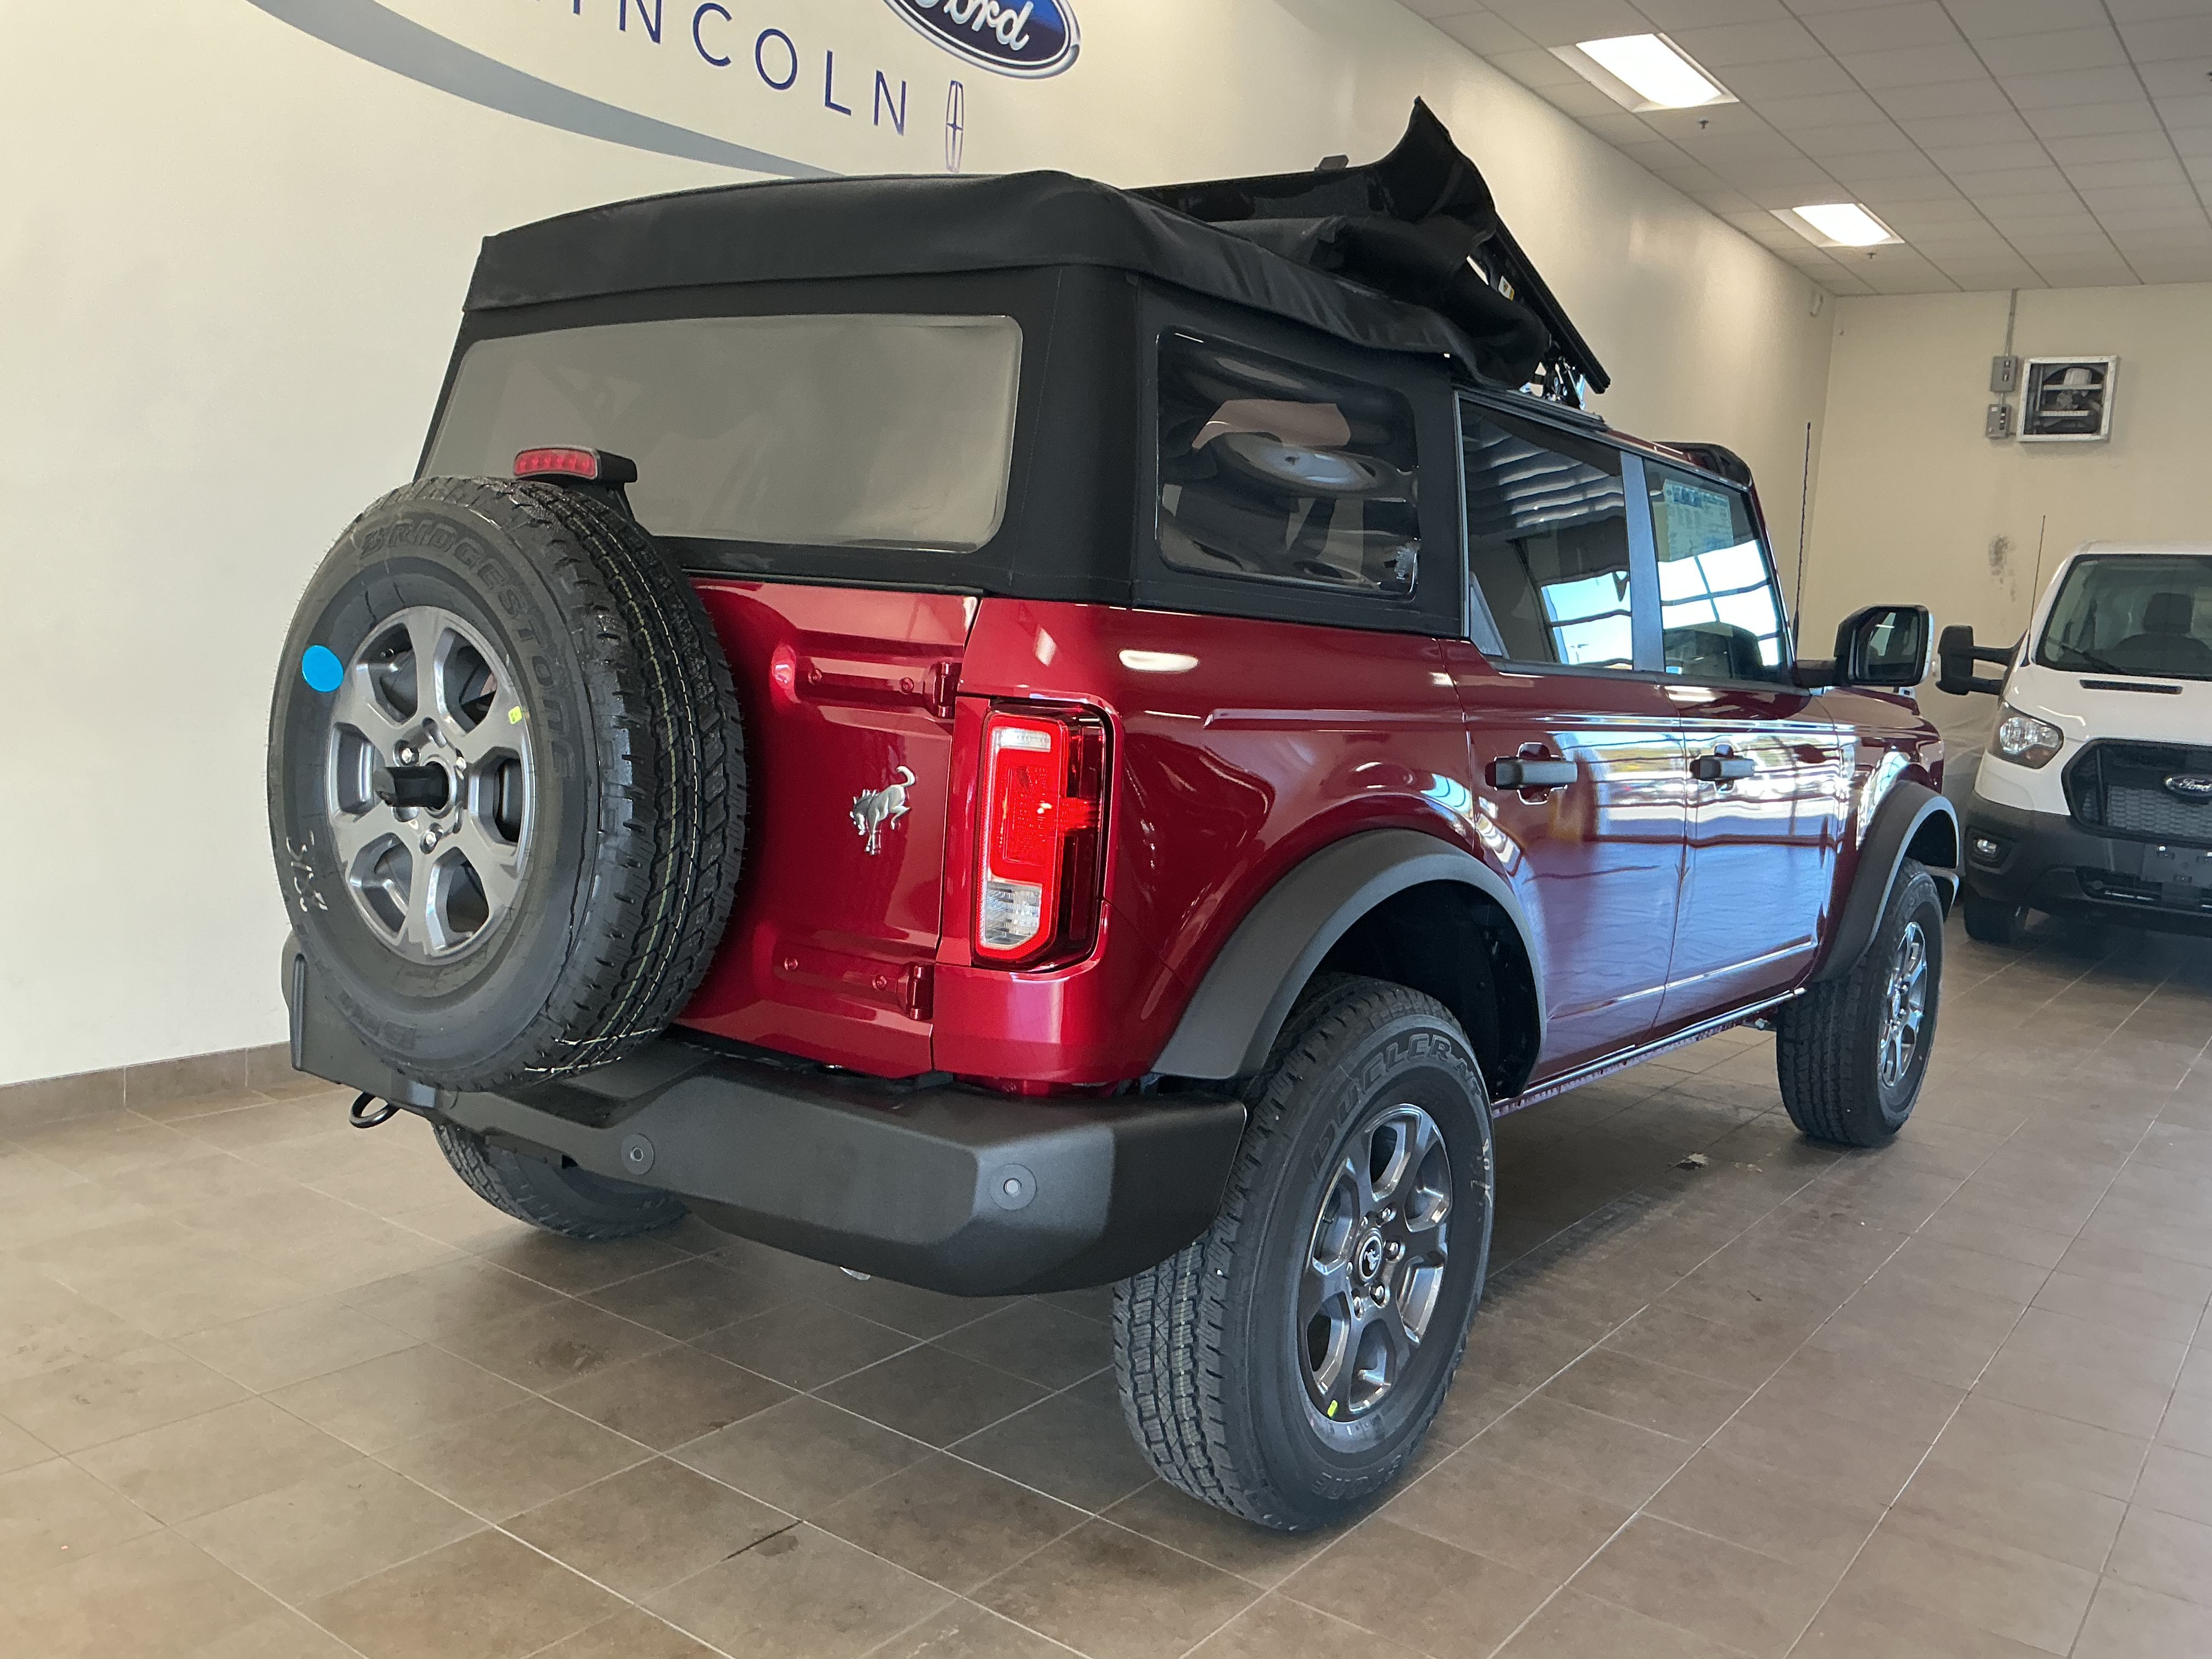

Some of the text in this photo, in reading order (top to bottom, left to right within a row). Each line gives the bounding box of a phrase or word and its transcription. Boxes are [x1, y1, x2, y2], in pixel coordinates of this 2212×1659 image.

[531, 0, 906, 136] NCOLN
[915, 0, 1029, 51] ord
[358, 518, 575, 776] BRIDGESTONE
[1312, 1033, 1452, 1178] DUELER
